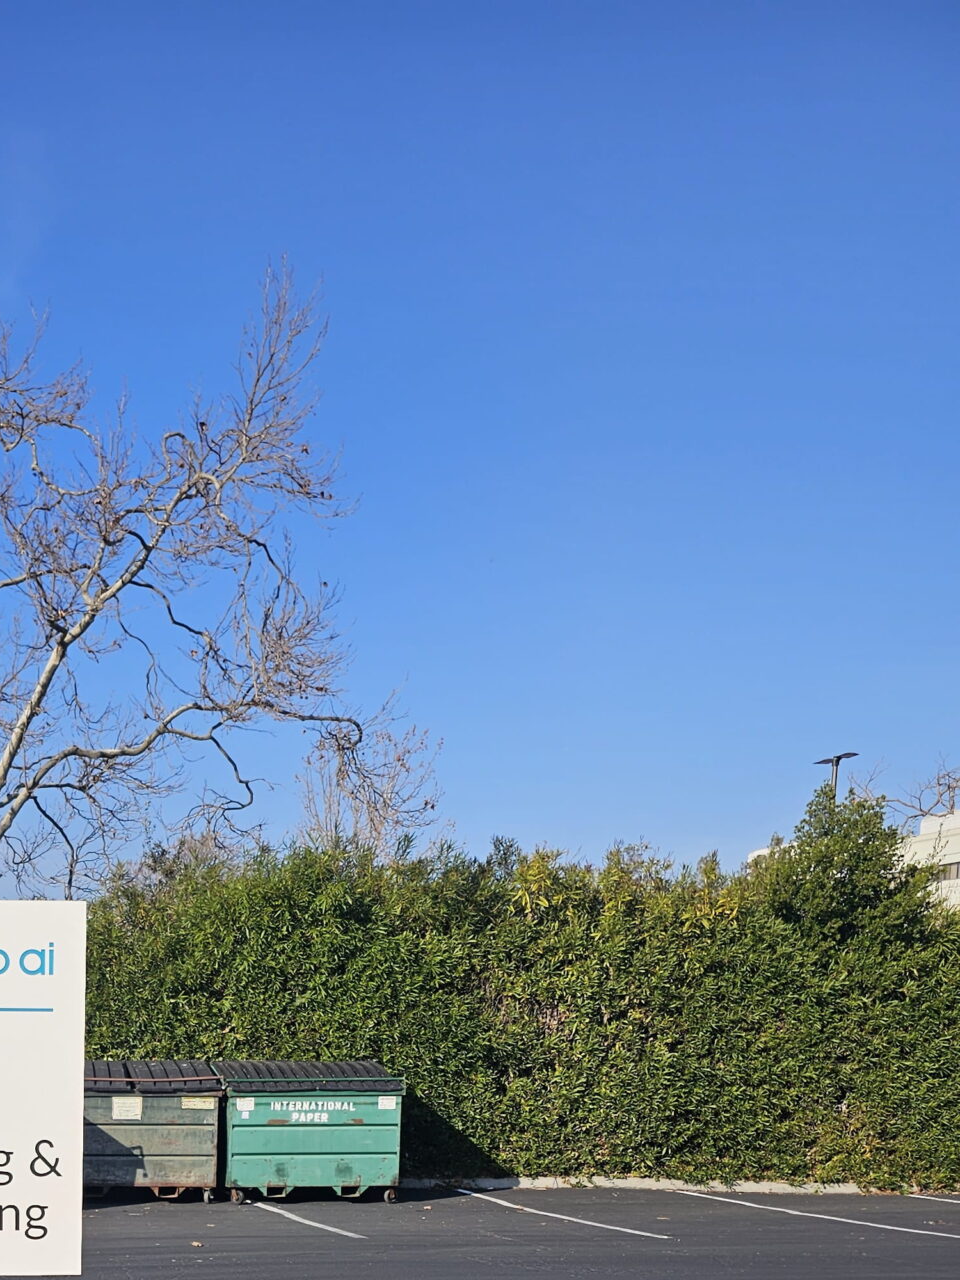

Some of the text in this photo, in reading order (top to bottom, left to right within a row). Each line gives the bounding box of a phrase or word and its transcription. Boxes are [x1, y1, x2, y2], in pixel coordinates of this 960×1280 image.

[19, 942, 54, 976] ai
[270, 1101, 356, 1112] INTERNATIONAL
[291, 1112, 329, 1122] PAPER
[29, 1139, 63, 1178] &
